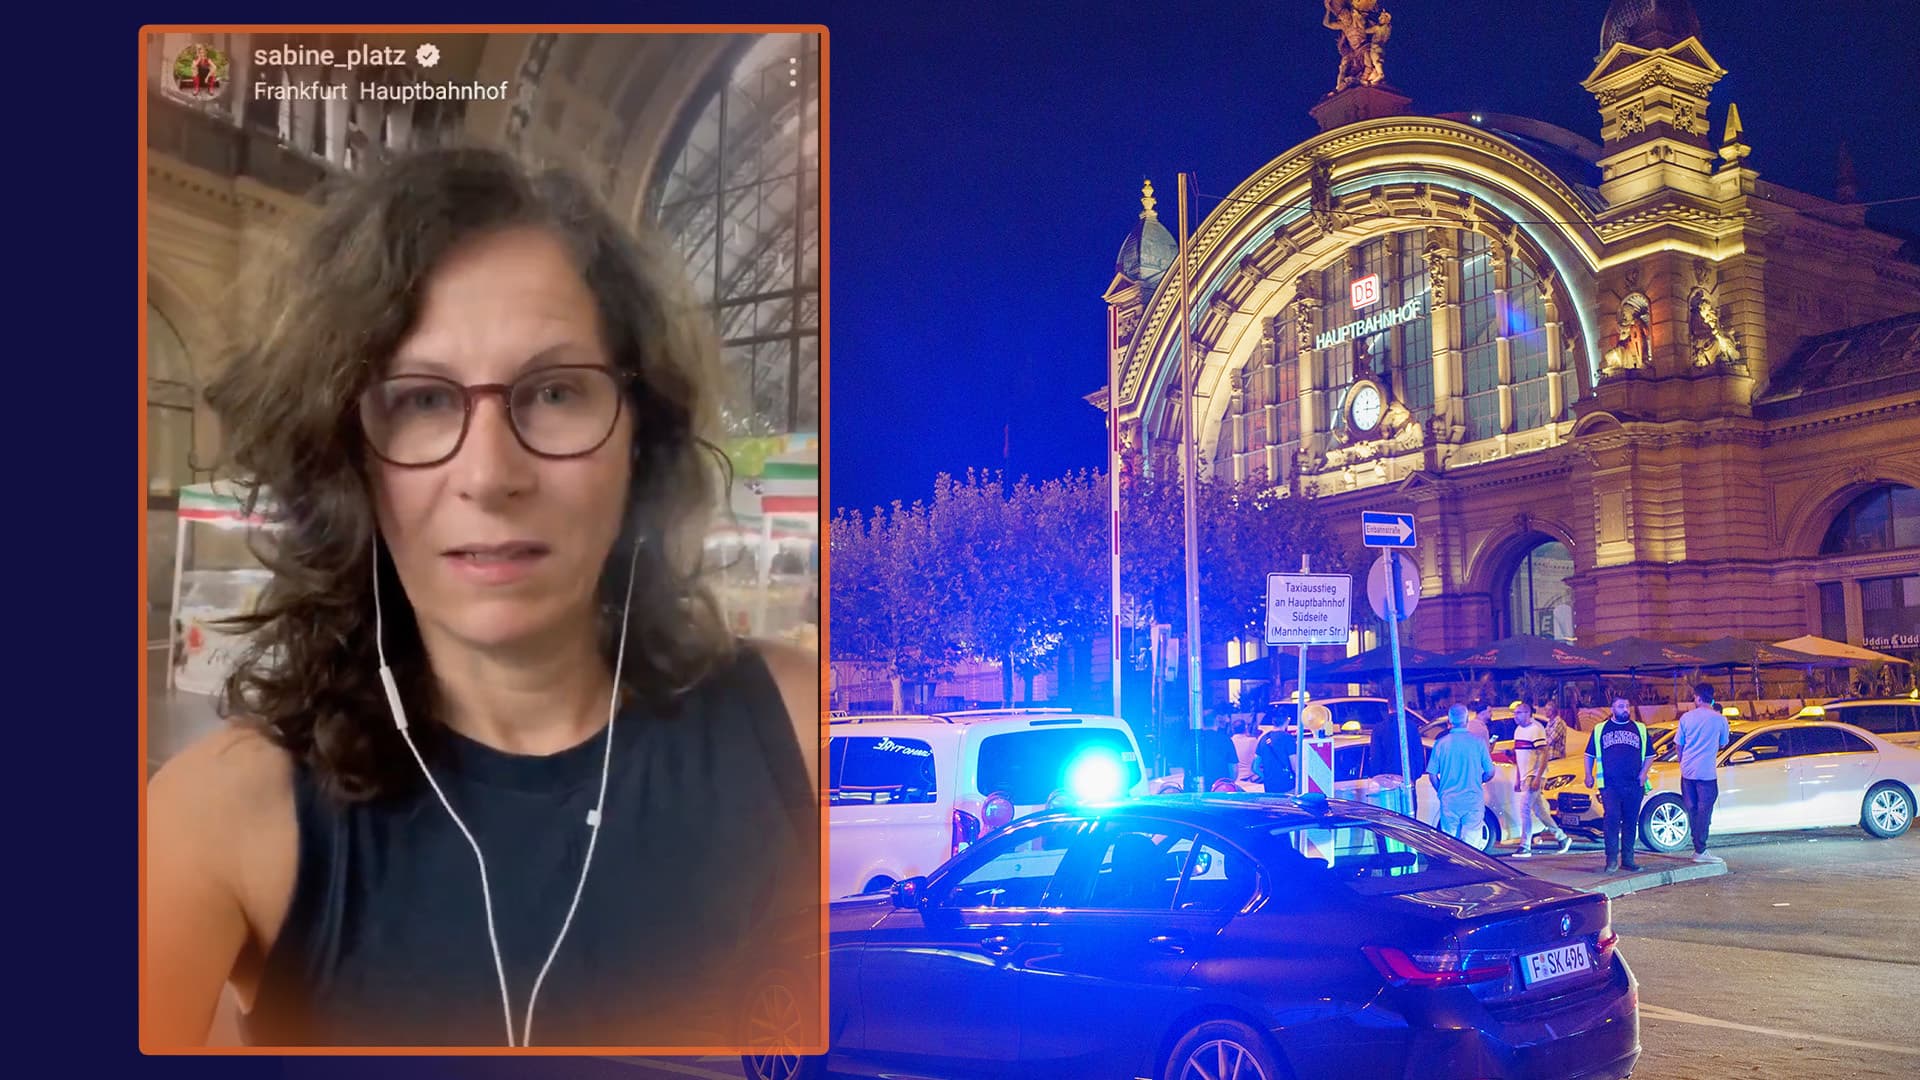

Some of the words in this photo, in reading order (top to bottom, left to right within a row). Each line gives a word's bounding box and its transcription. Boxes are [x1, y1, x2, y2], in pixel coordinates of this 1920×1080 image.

[1355, 280, 1374, 303] DB
[1315, 299, 1422, 350] HAUPTBAHNHOF
[1286, 582, 1336, 595] Taxiausstieg
[1275, 599, 1286, 607] an
[1288, 597, 1346, 610] Hauptbahnhof
[1292, 611, 1328, 622] Südseite
[1271, 626, 1327, 637] (Mannheimer
[1862, 637, 1889, 646] Uddin
[1532, 956, 1540, 978] F
[1547, 951, 1564, 974] SK
[1564, 946, 1584, 970] 496
